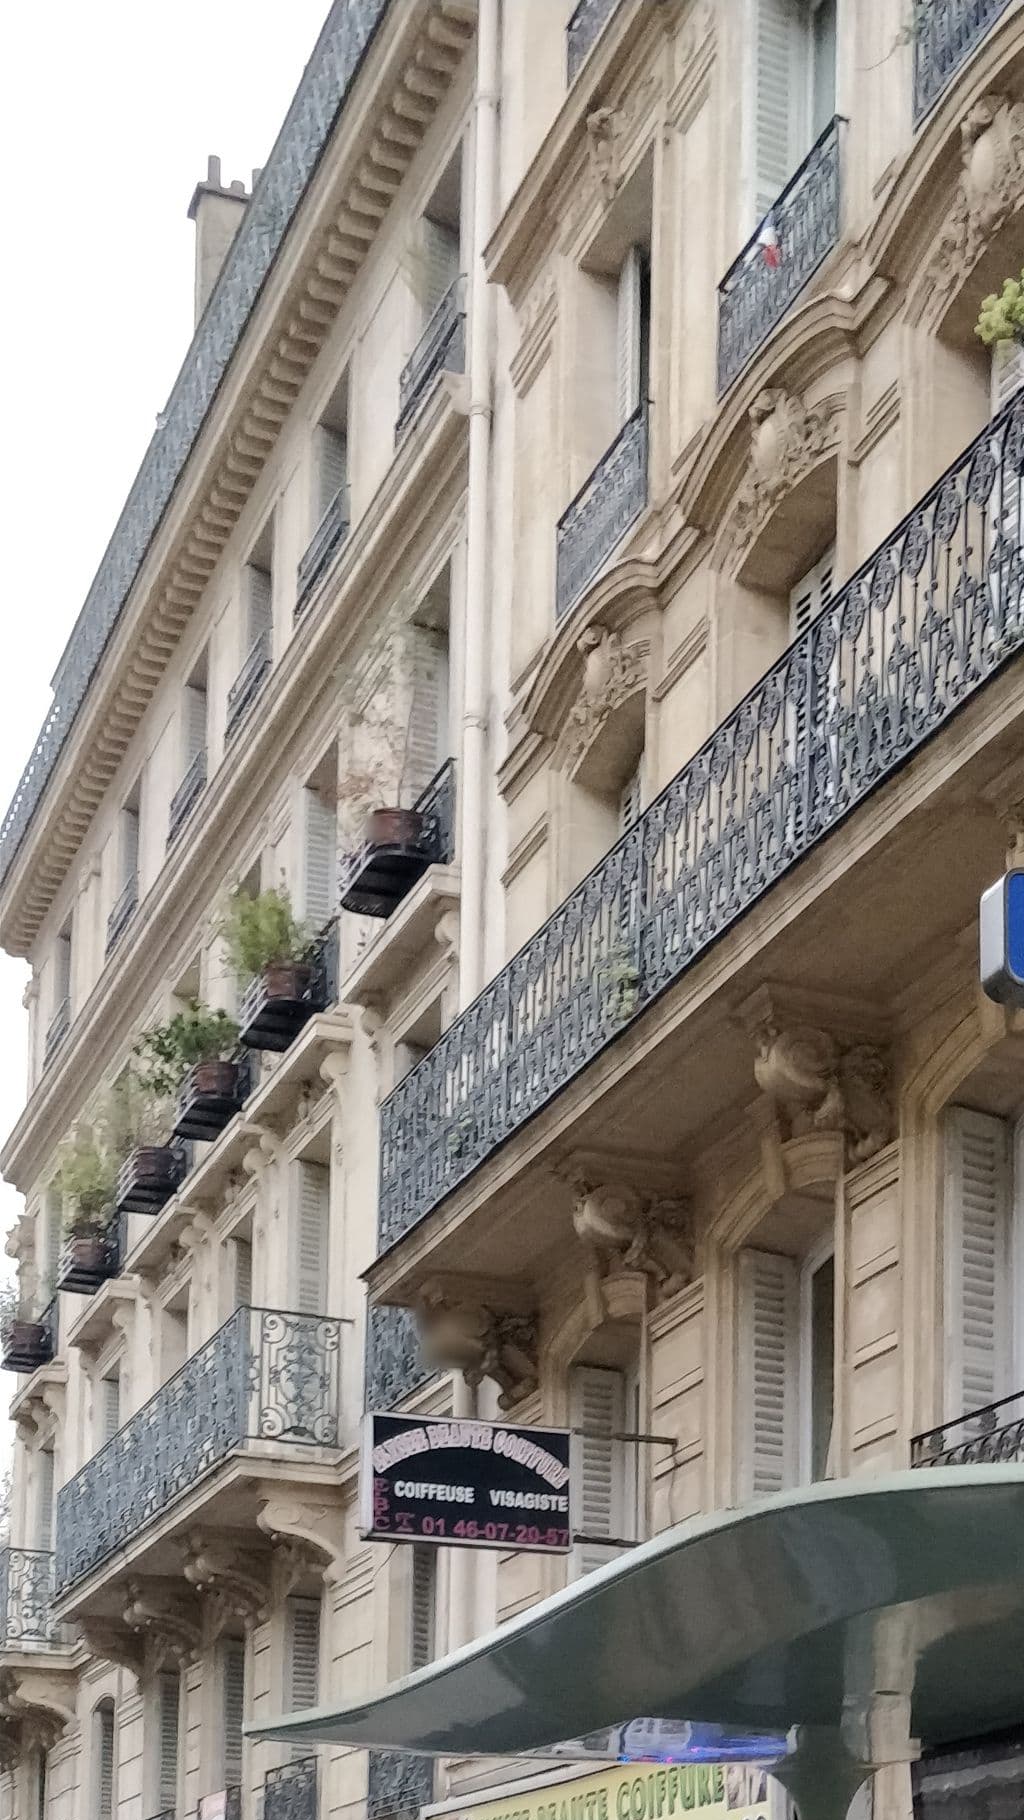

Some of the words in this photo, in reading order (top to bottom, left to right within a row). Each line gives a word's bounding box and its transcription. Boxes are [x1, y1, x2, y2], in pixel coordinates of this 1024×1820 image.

[394, 1480, 475, 1504] COIFFEUSE
[489, 1489, 569, 1512] VISAGISTE
[422, 1516, 445, 1535] 01
